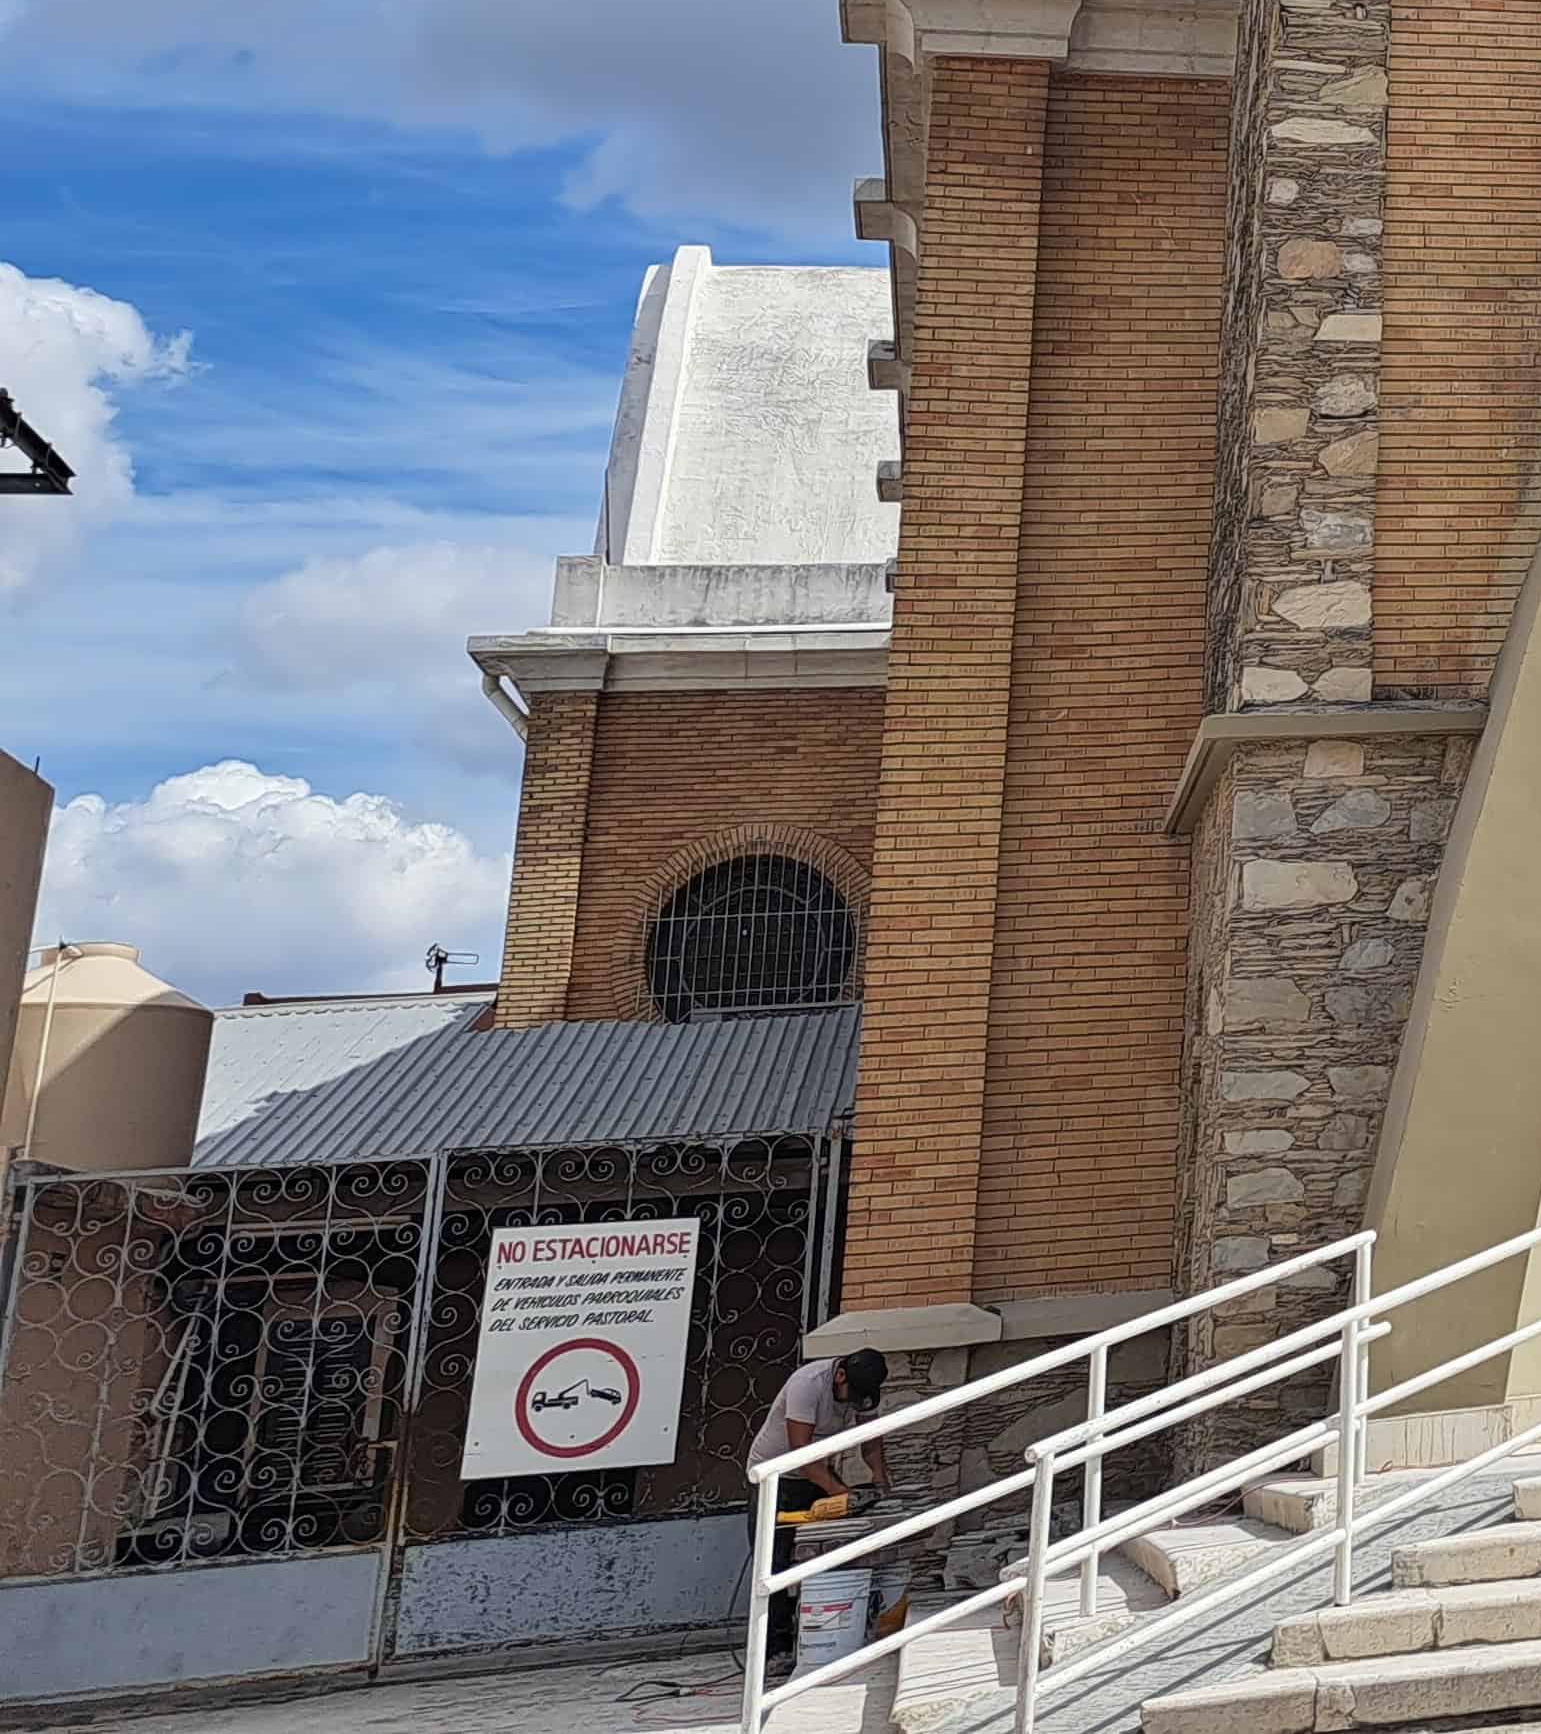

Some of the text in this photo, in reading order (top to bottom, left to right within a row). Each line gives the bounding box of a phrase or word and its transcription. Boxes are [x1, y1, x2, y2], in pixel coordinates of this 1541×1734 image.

[497, 1232, 691, 1263] NO ESTACIONARSE
[494, 1267, 688, 1291] ENTRADA Y SALIDA PERMANENTE
[491, 1286, 685, 1312] DE VEHICULOS PARROQUIALES
[488, 1318, 516, 1332] DEL
[518, 1314, 580, 1331] SERVICIO
